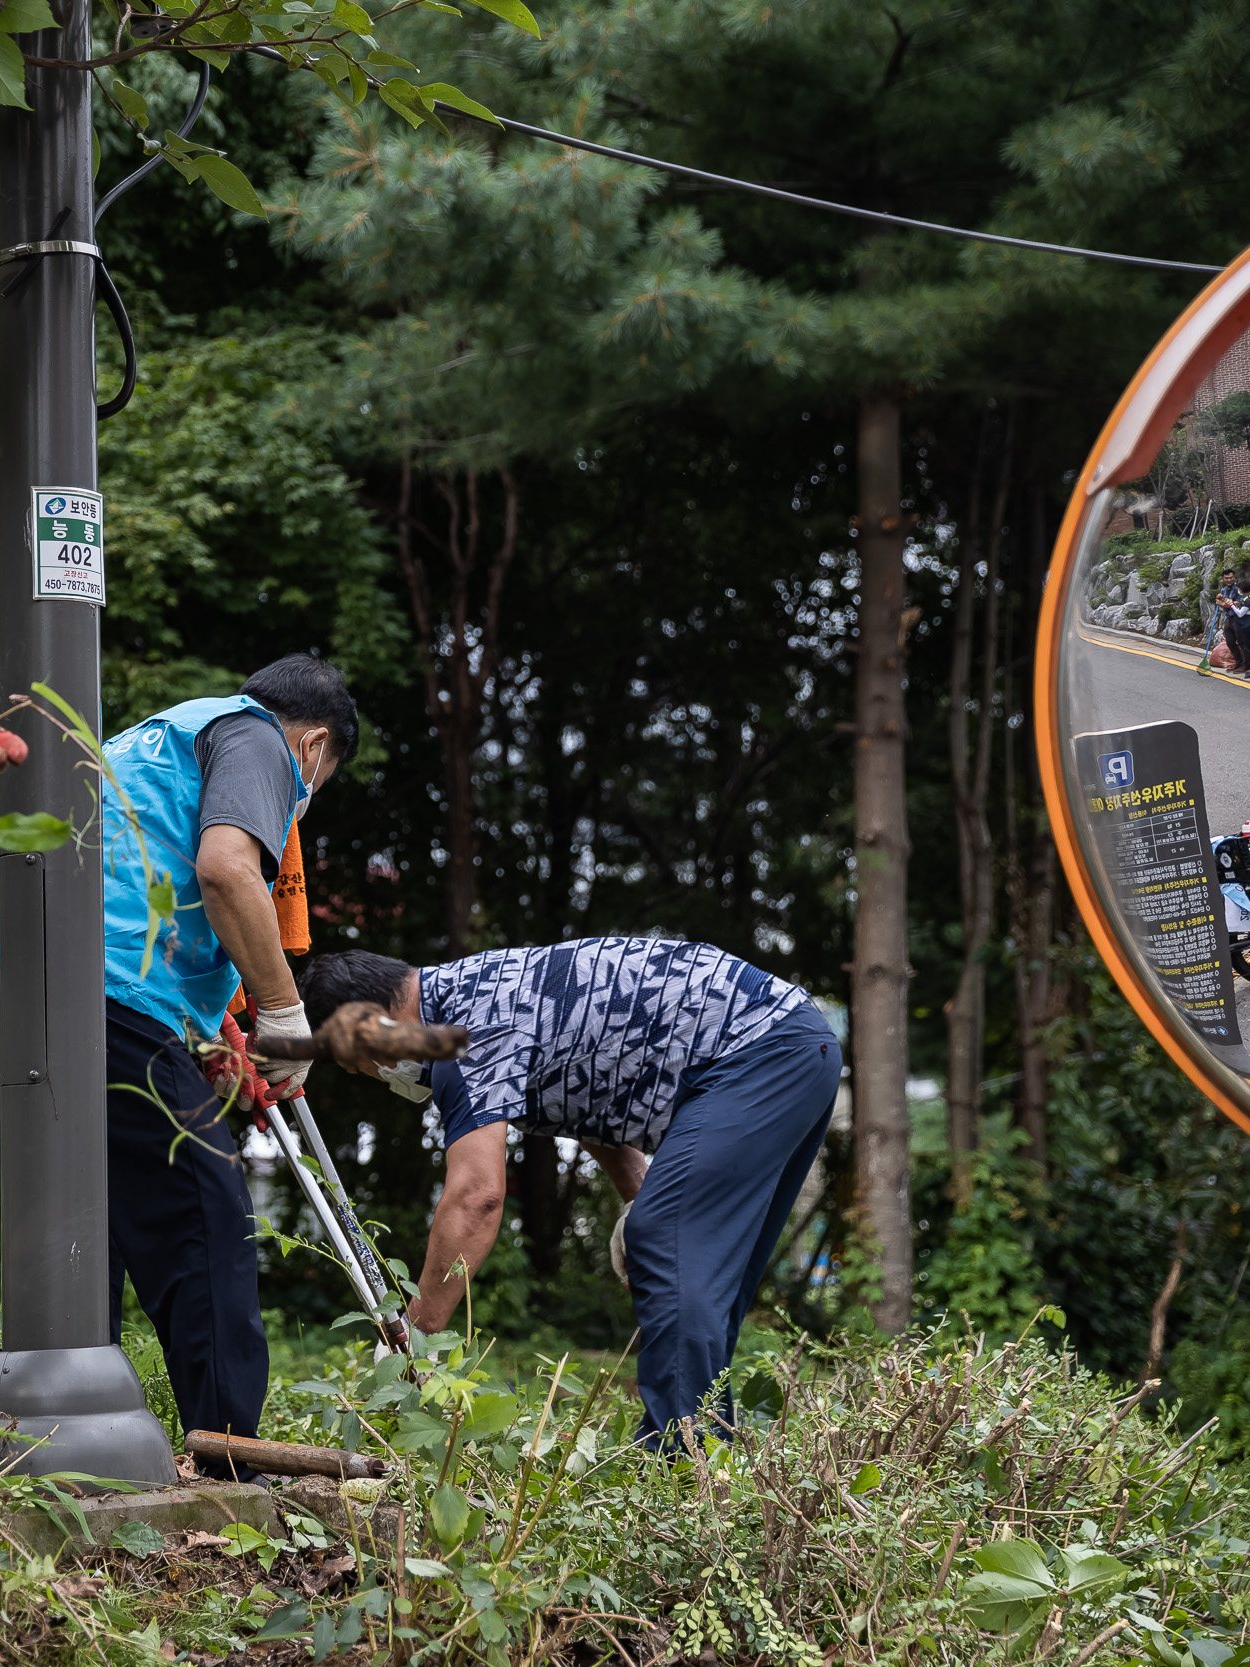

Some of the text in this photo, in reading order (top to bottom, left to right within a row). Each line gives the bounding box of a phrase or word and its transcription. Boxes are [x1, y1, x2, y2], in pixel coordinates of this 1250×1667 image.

[70, 500, 97, 519] 보안등
[58, 544, 92, 567] 402
[64, 570, 88, 579] 고장신고
[45, 579, 101, 595] 450-7873,7875
